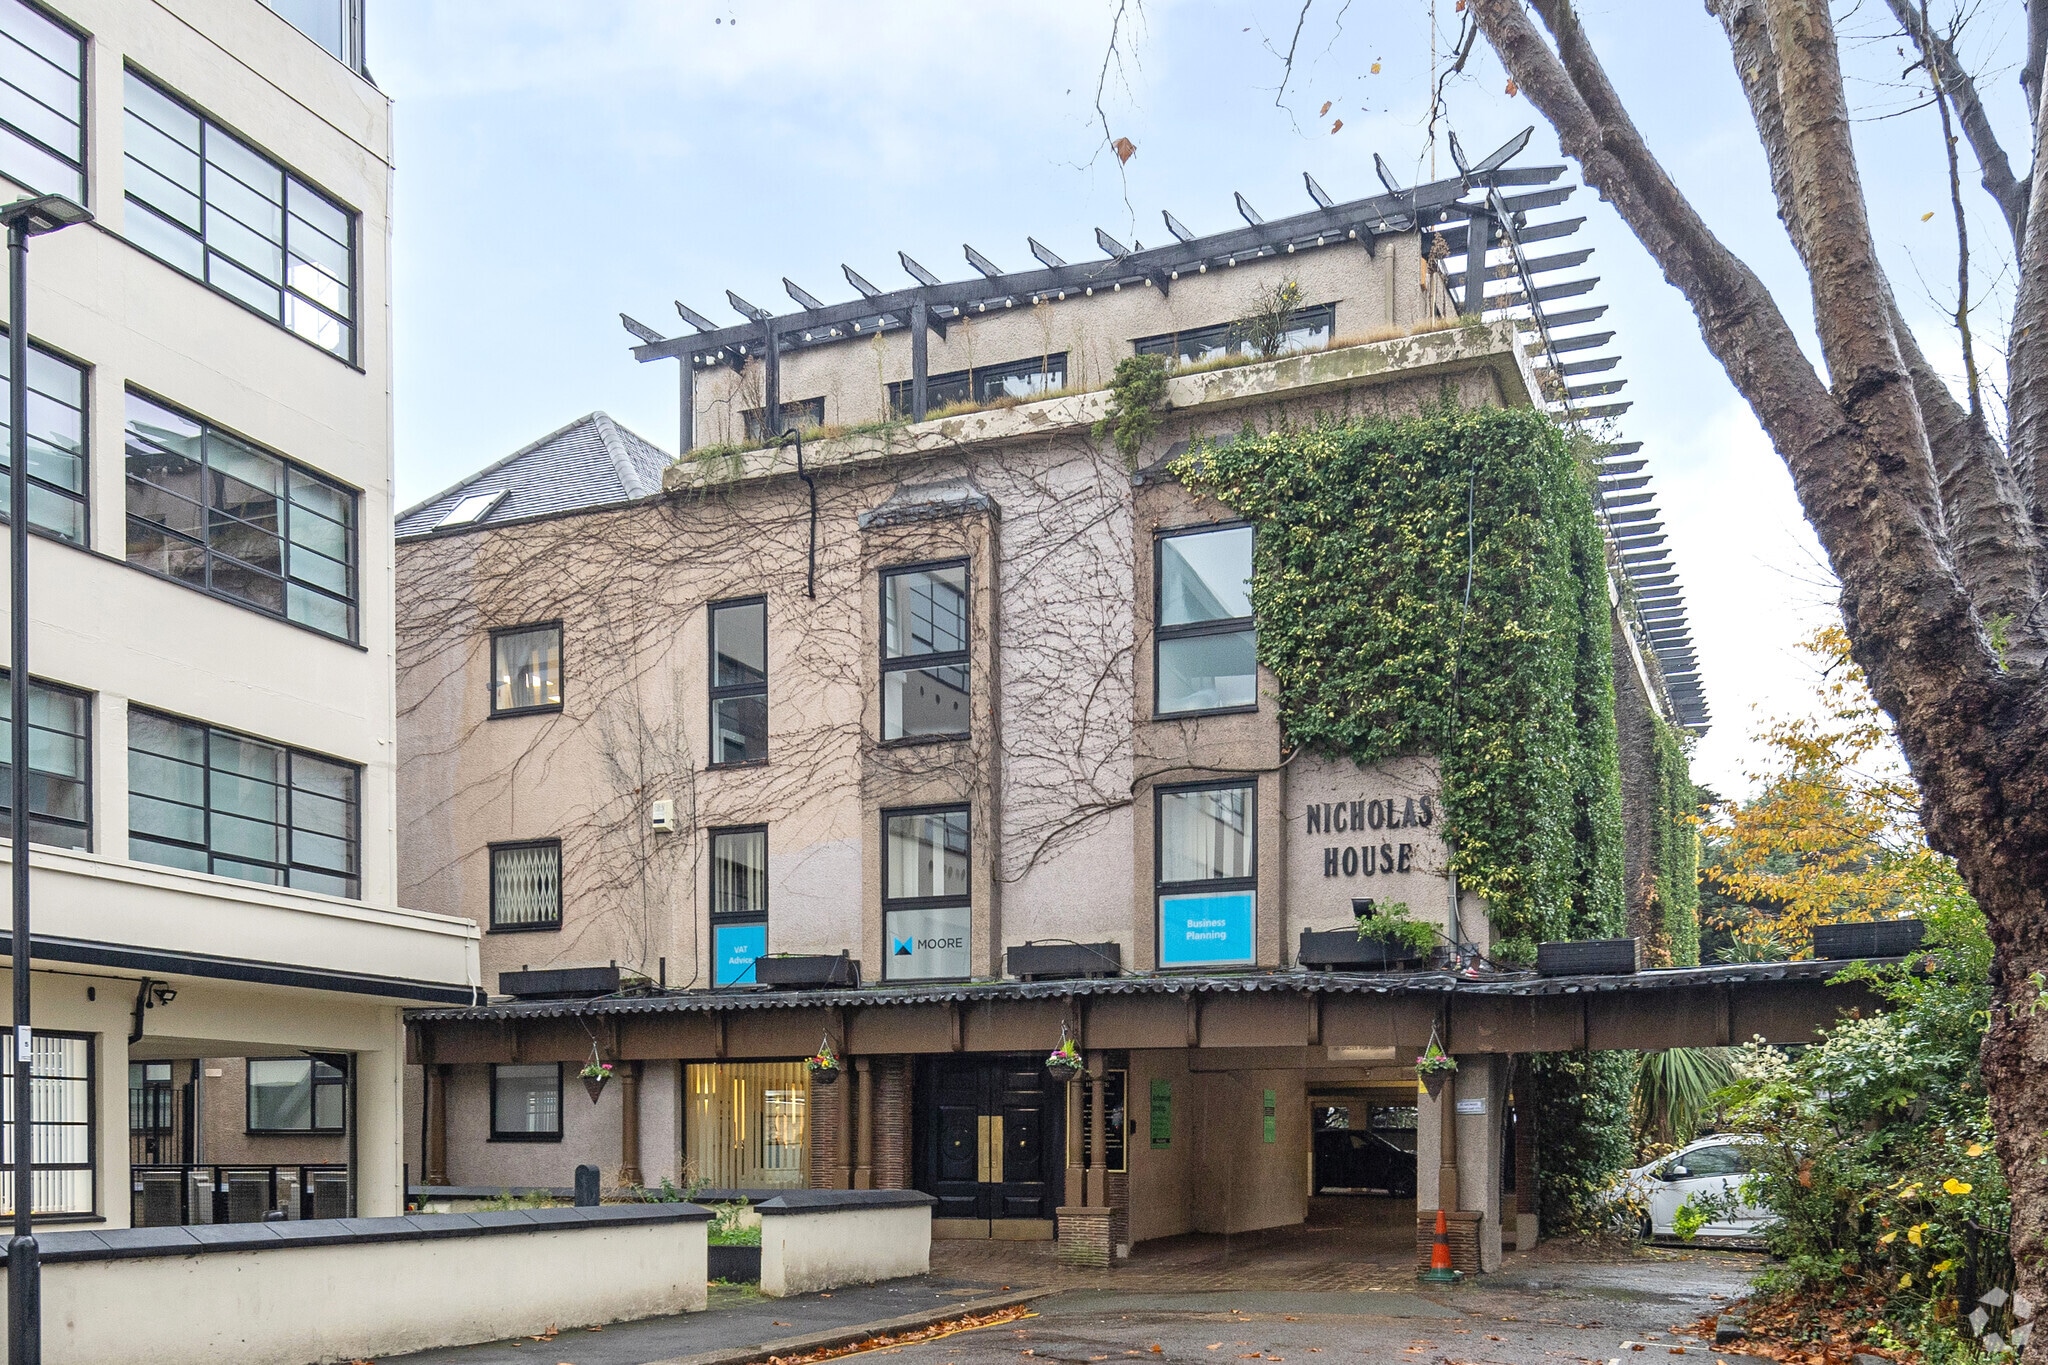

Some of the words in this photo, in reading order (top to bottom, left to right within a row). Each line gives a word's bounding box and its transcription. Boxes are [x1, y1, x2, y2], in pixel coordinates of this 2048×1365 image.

[1307, 795, 1433, 834] NICHOLAS
[1324, 843, 1412, 877] HOUSE
[1187, 919, 1226, 928] Business
[1186, 931, 1226, 940] Planning
[918, 938, 963, 949] MOORE
[734, 946, 748, 954] VAT
[729, 956, 753, 965] Advice
